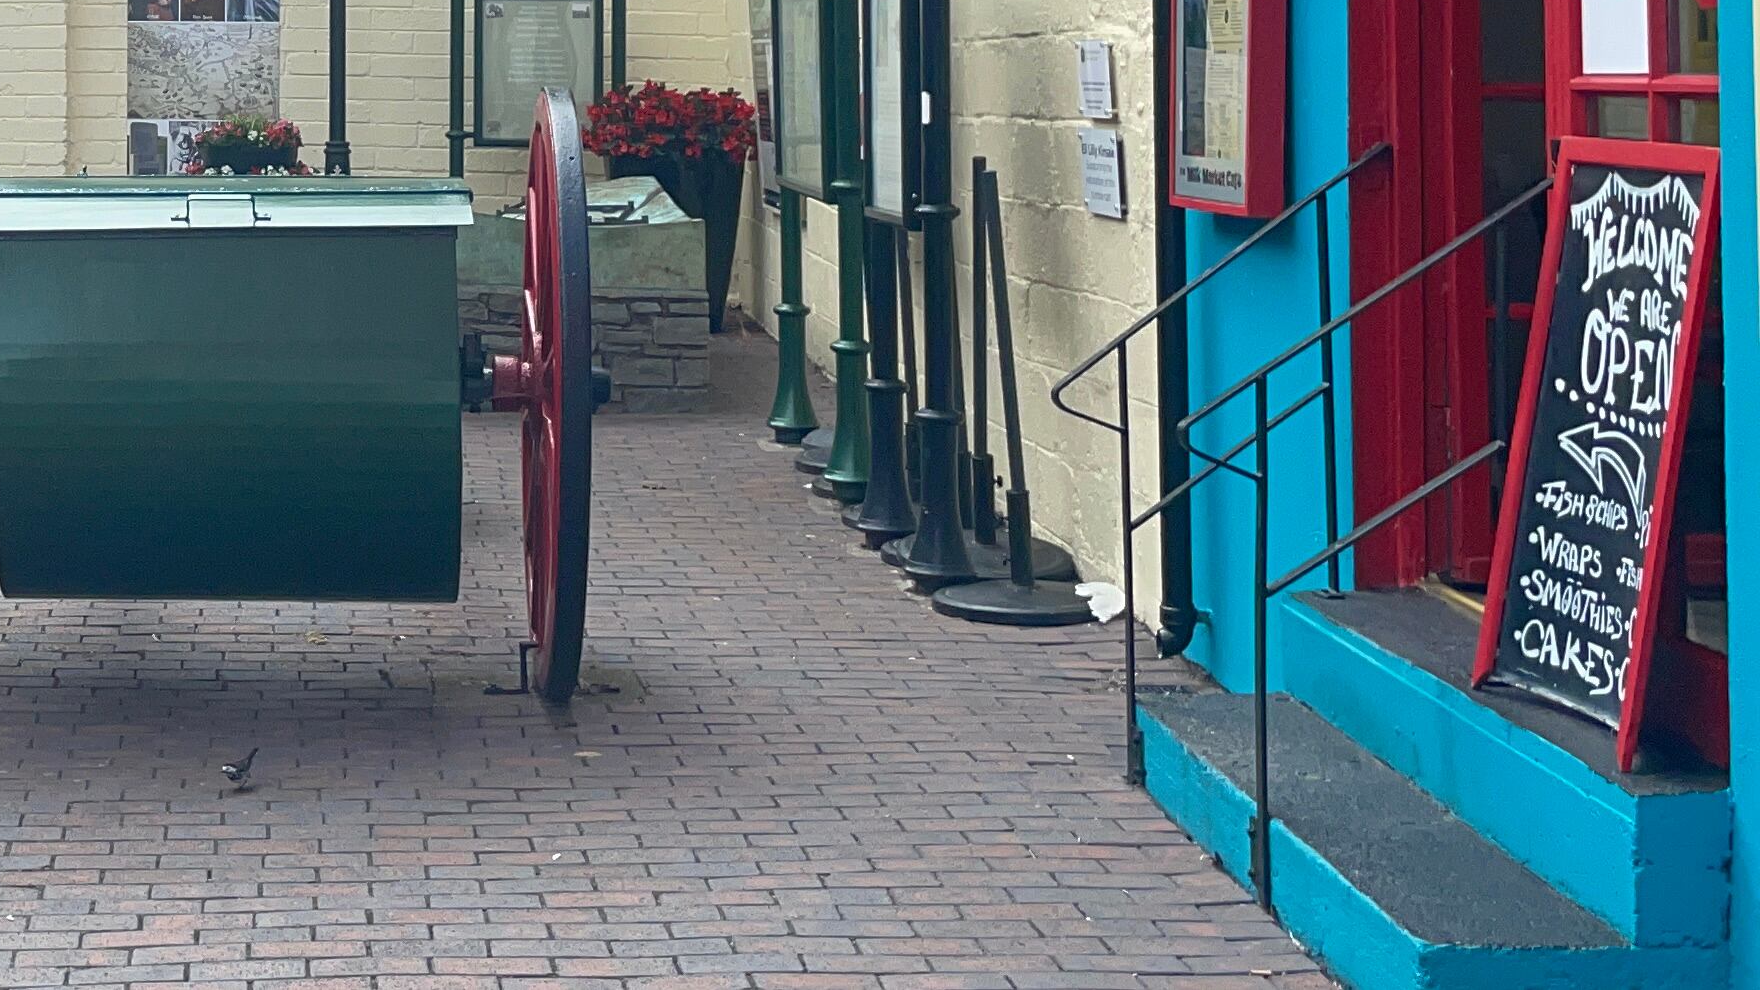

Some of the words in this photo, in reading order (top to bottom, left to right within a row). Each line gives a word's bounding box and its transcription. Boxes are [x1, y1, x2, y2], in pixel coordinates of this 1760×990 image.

[1581, 206, 1694, 301] WELCOME
[1607, 288, 1635, 322] WE
[1640, 288, 1672, 336] ARE
[1580, 308, 1682, 415] OPEN
[1537, 525, 1603, 579] WRAPS
[1520, 619, 1615, 695] CAKES
